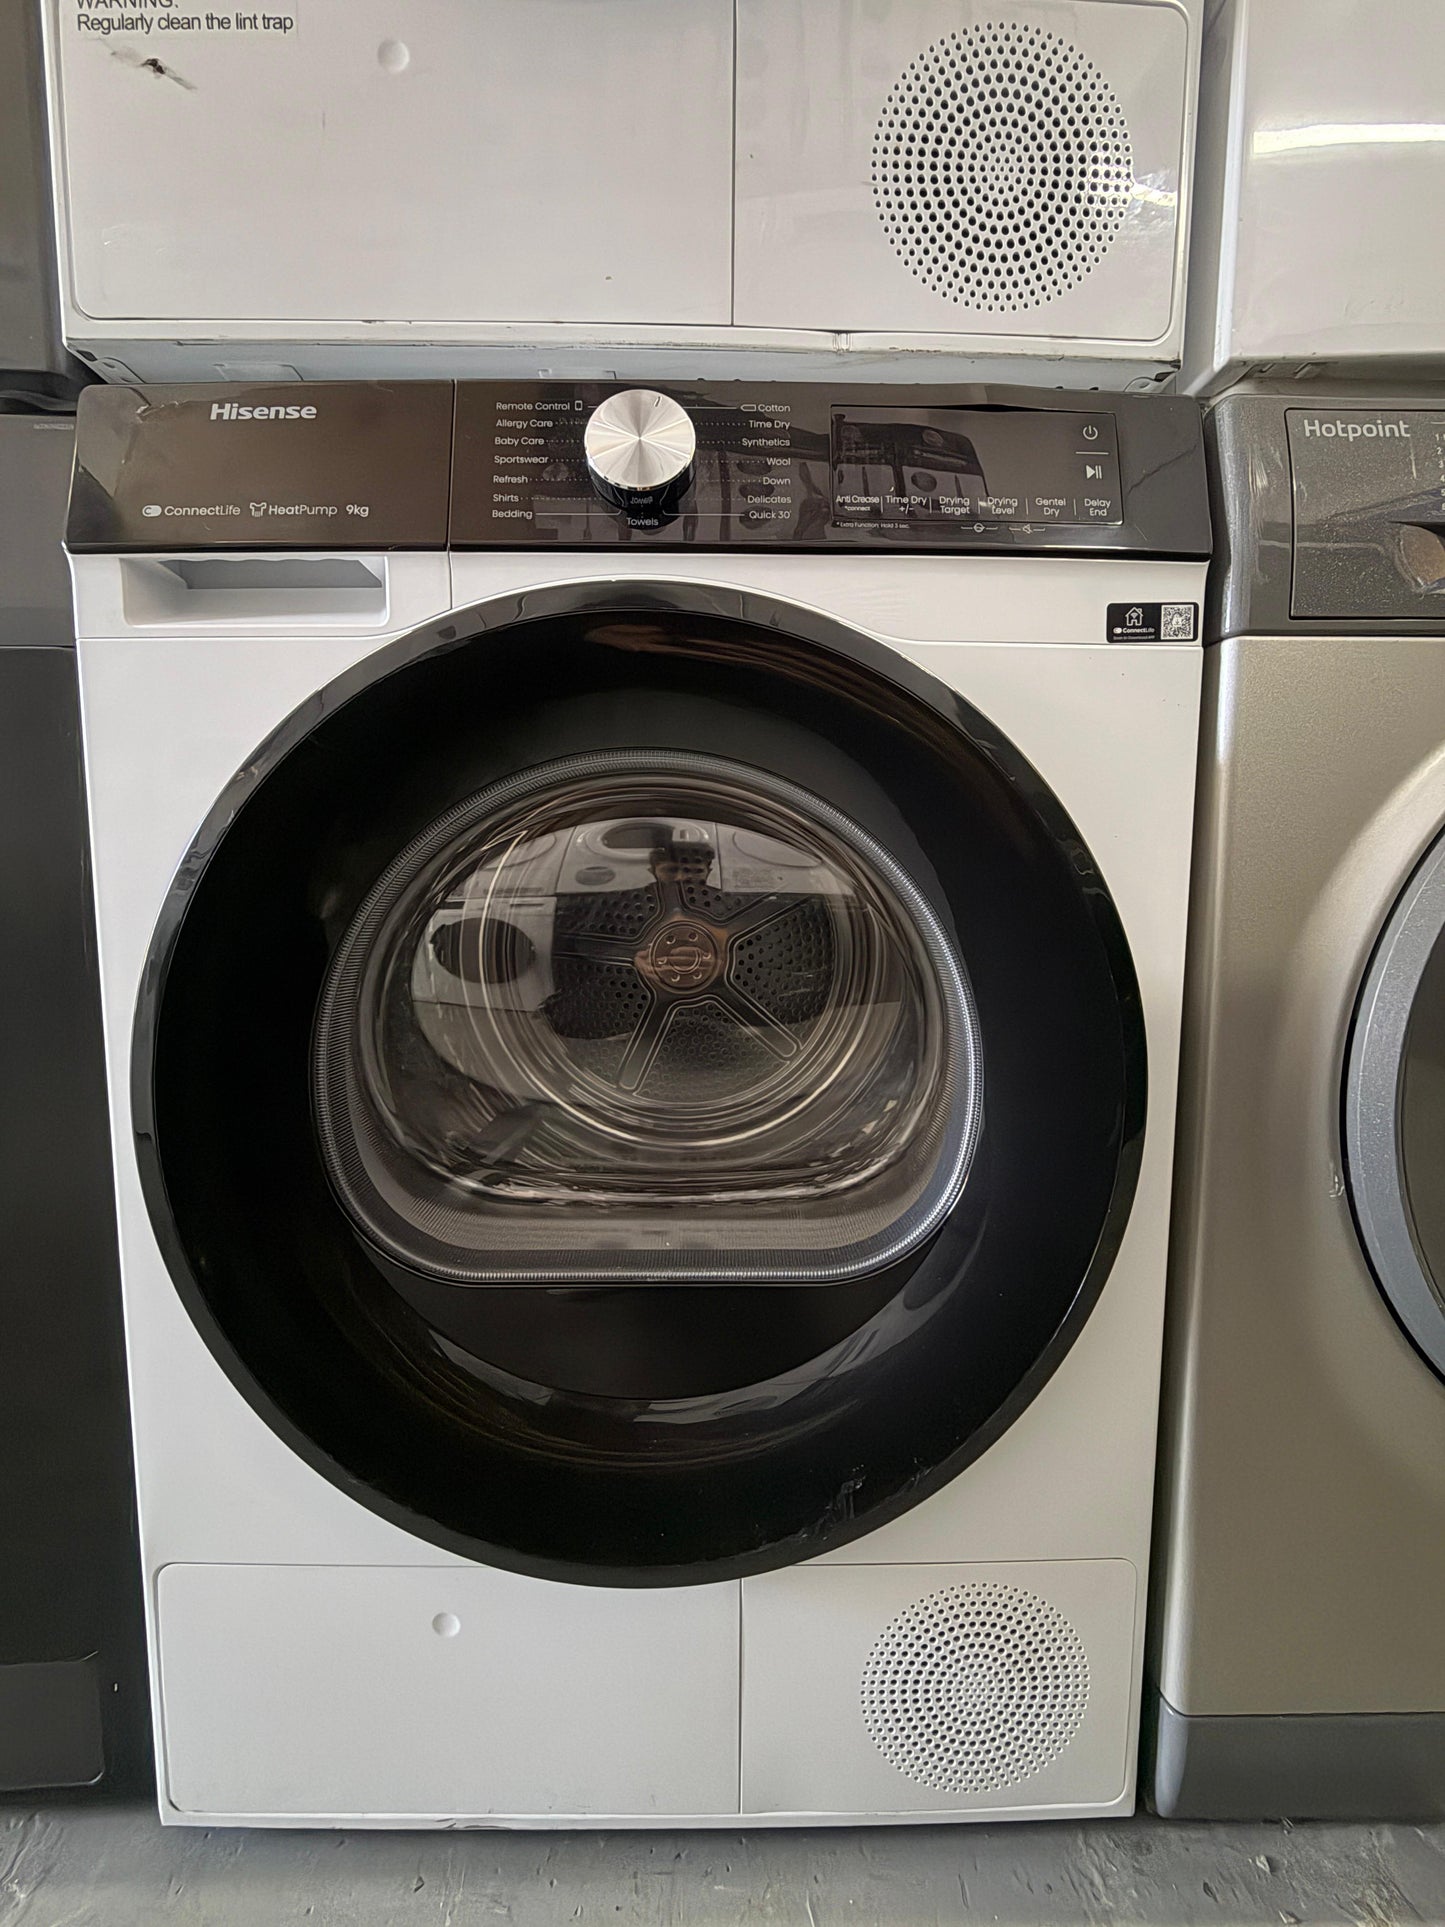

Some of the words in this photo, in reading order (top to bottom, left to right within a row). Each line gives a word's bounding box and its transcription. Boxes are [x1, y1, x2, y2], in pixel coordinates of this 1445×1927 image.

[78, 14, 153, 35] Regularly
[158, 13, 200, 30] clean
[206, 13, 230, 30] the
[236, 13, 258, 30] lint
[263, 14, 293, 34] trap
[496, 402, 532, 411] Remote
[535, 402, 570, 411] Control
[758, 404, 790, 412] Cotton
[209, 403, 318, 420] Hisense
[496, 419, 527, 429] Allergy
[530, 419, 553, 428] Care
[749, 420, 773, 428] Time
[775, 420, 790, 430] Dry
[1304, 419, 1410, 441] Hotpoint
[495, 436, 520, 446] Baby
[522, 437, 544, 445] Care
[742, 438, 790, 448] Synthetics
[1437, 447, 1442, 455] 2
[494, 455, 549, 465] Sportswear
[767, 458, 790, 466] Wool
[493, 475, 528, 484] Refresh
[763, 477, 790, 485] Down
[493, 494, 519, 502] Shirts
[748, 495, 791, 504] Delicates
[911, 496, 926, 506] Dry
[940, 496, 970, 505] Drying
[988, 497, 1018, 506] Drying
[1036, 498, 1066, 506] Gentel
[1084, 499, 1111, 508] Delay
[165, 505, 241, 516] ConnectLife
[269, 504, 338, 518] HeatPump
[346, 505, 369, 518] 9kg
[492, 510, 532, 519] Bedding
[940, 506, 970, 515] Target
[992, 506, 1015, 514] Level
[1044, 508, 1059, 517] Dry
[749, 511, 776, 520] Quick
[626, 517, 659, 526] Towels
